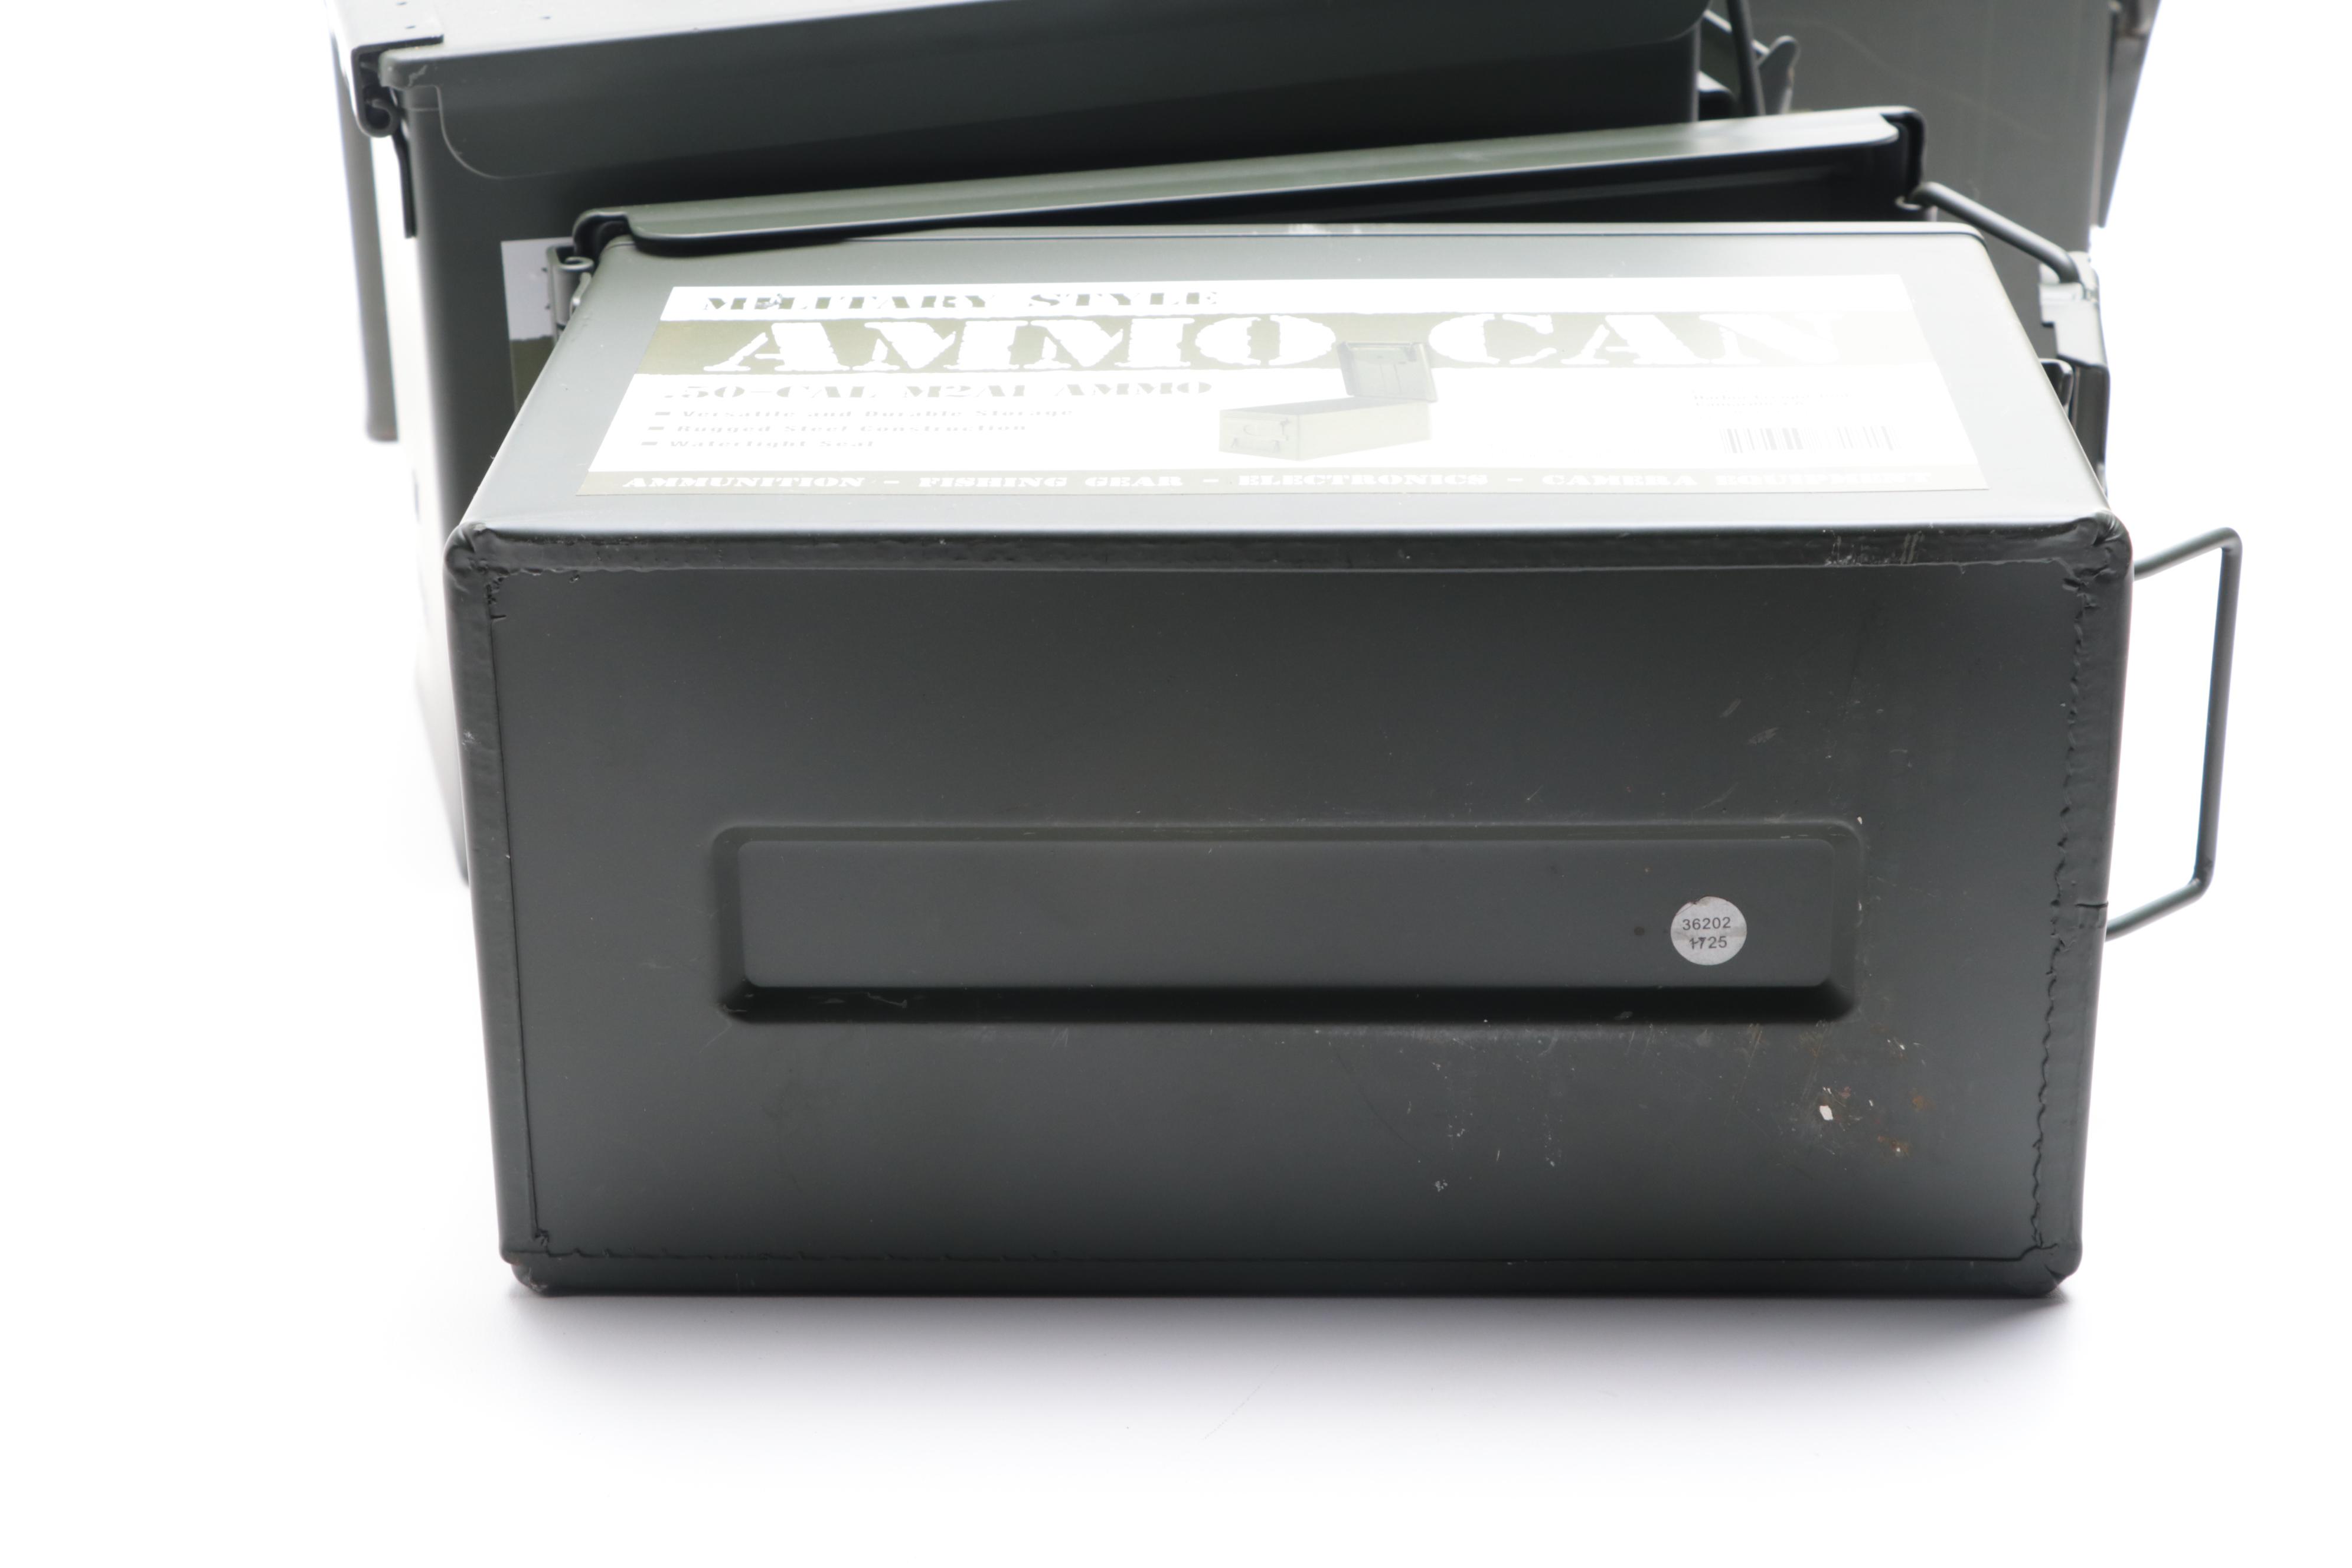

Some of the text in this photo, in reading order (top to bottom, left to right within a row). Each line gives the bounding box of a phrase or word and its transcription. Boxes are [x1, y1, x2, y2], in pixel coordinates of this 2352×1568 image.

[703, 292, 1219, 311] MILITARY STYLE
[703, 313, 1843, 371] AMMO CAN
[1054, 382, 1212, 396] AMMO
[622, 477, 865, 487] AMMUNITION
[917, 477, 1067, 487] FISHING
[1085, 476, 1182, 486] GEAR
[1238, 474, 1488, 486] ELECTRONICS
[1541, 474, 1698, 486] CAMERA
[1714, 472, 1932, 485] EQUIPMENT
[1682, 917, 1731, 930] 36202
